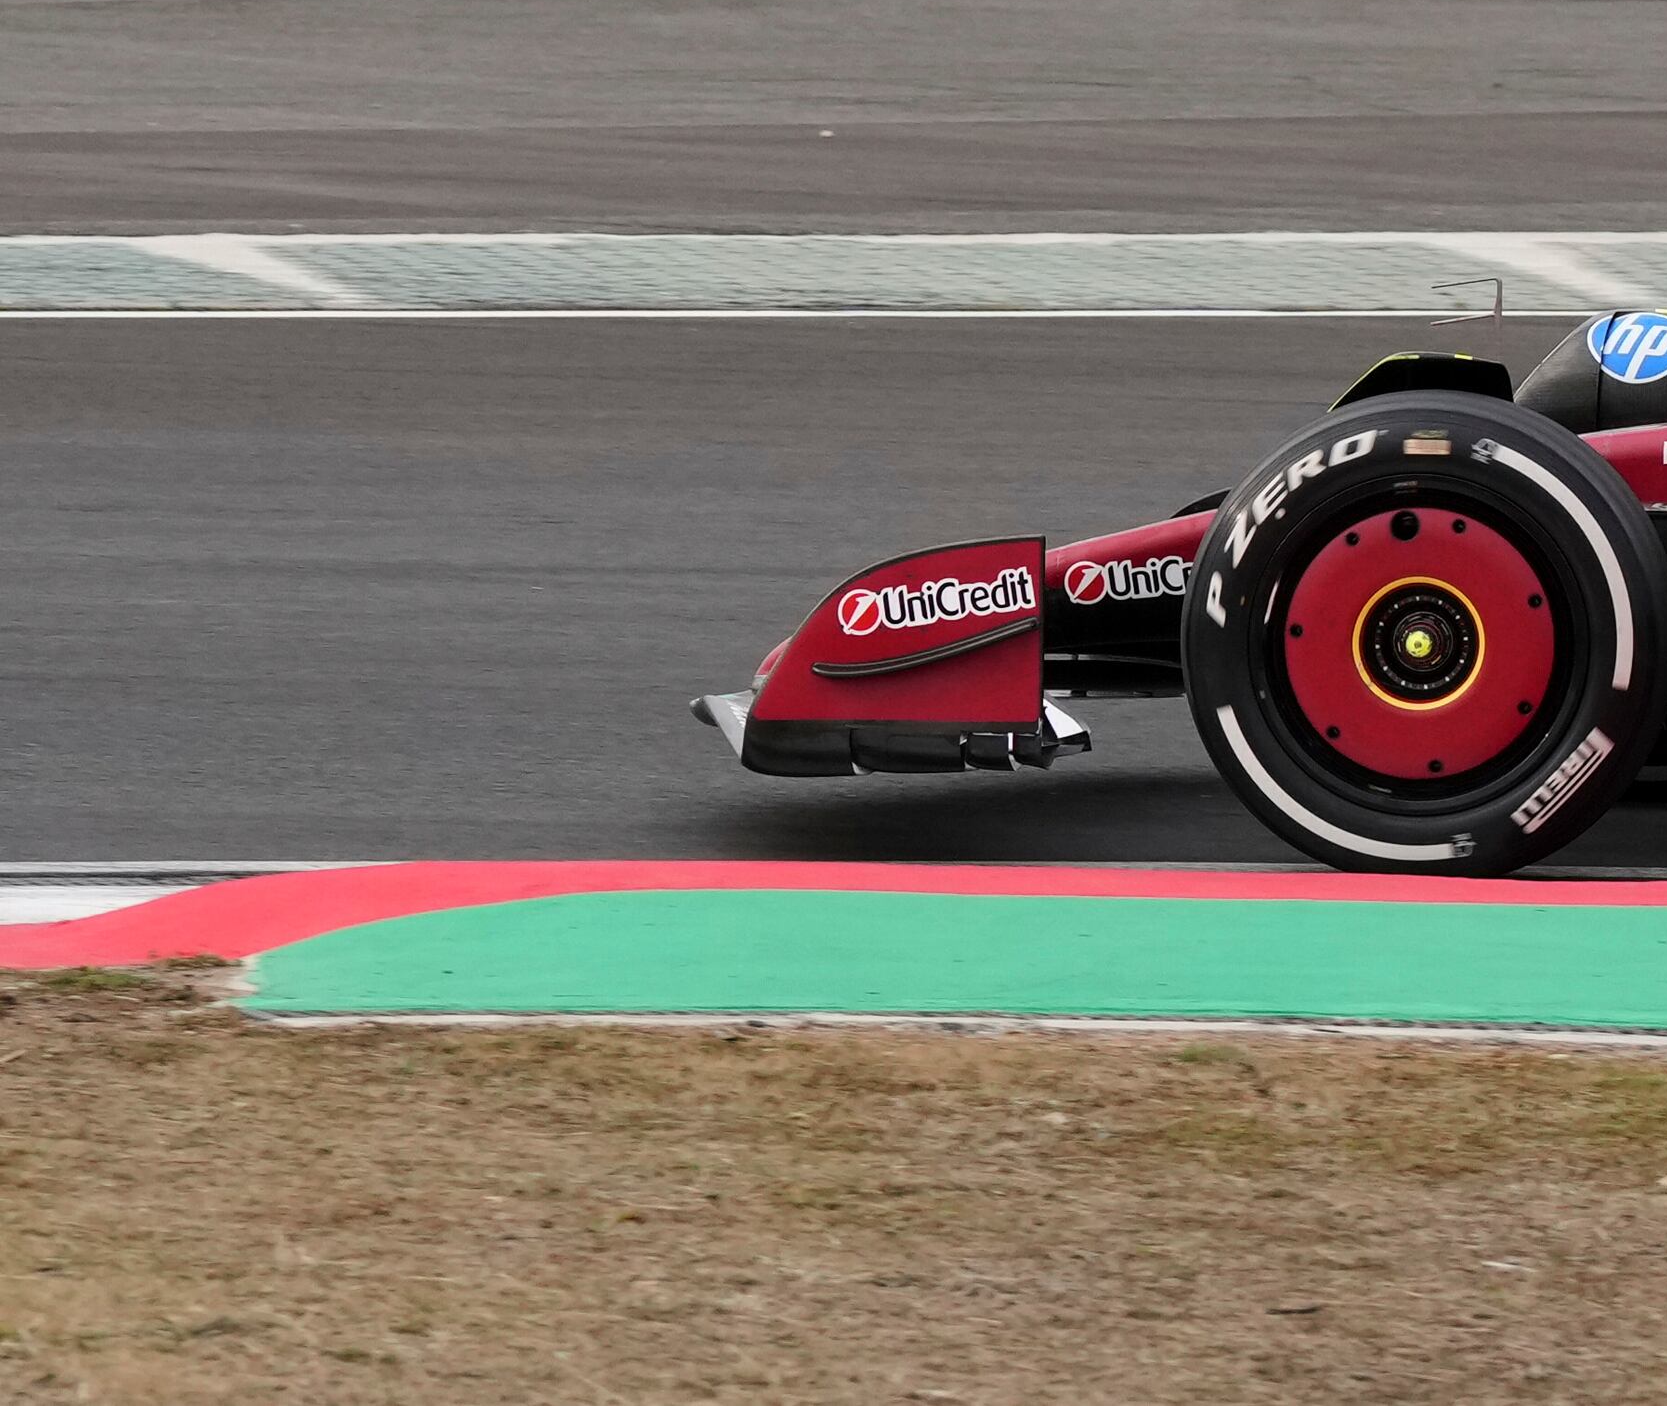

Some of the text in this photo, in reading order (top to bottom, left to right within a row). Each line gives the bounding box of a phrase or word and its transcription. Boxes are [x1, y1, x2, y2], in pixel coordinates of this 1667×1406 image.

[1205, 428, 1380, 628] P ZERO
[880, 568, 1034, 627] UniCredit
